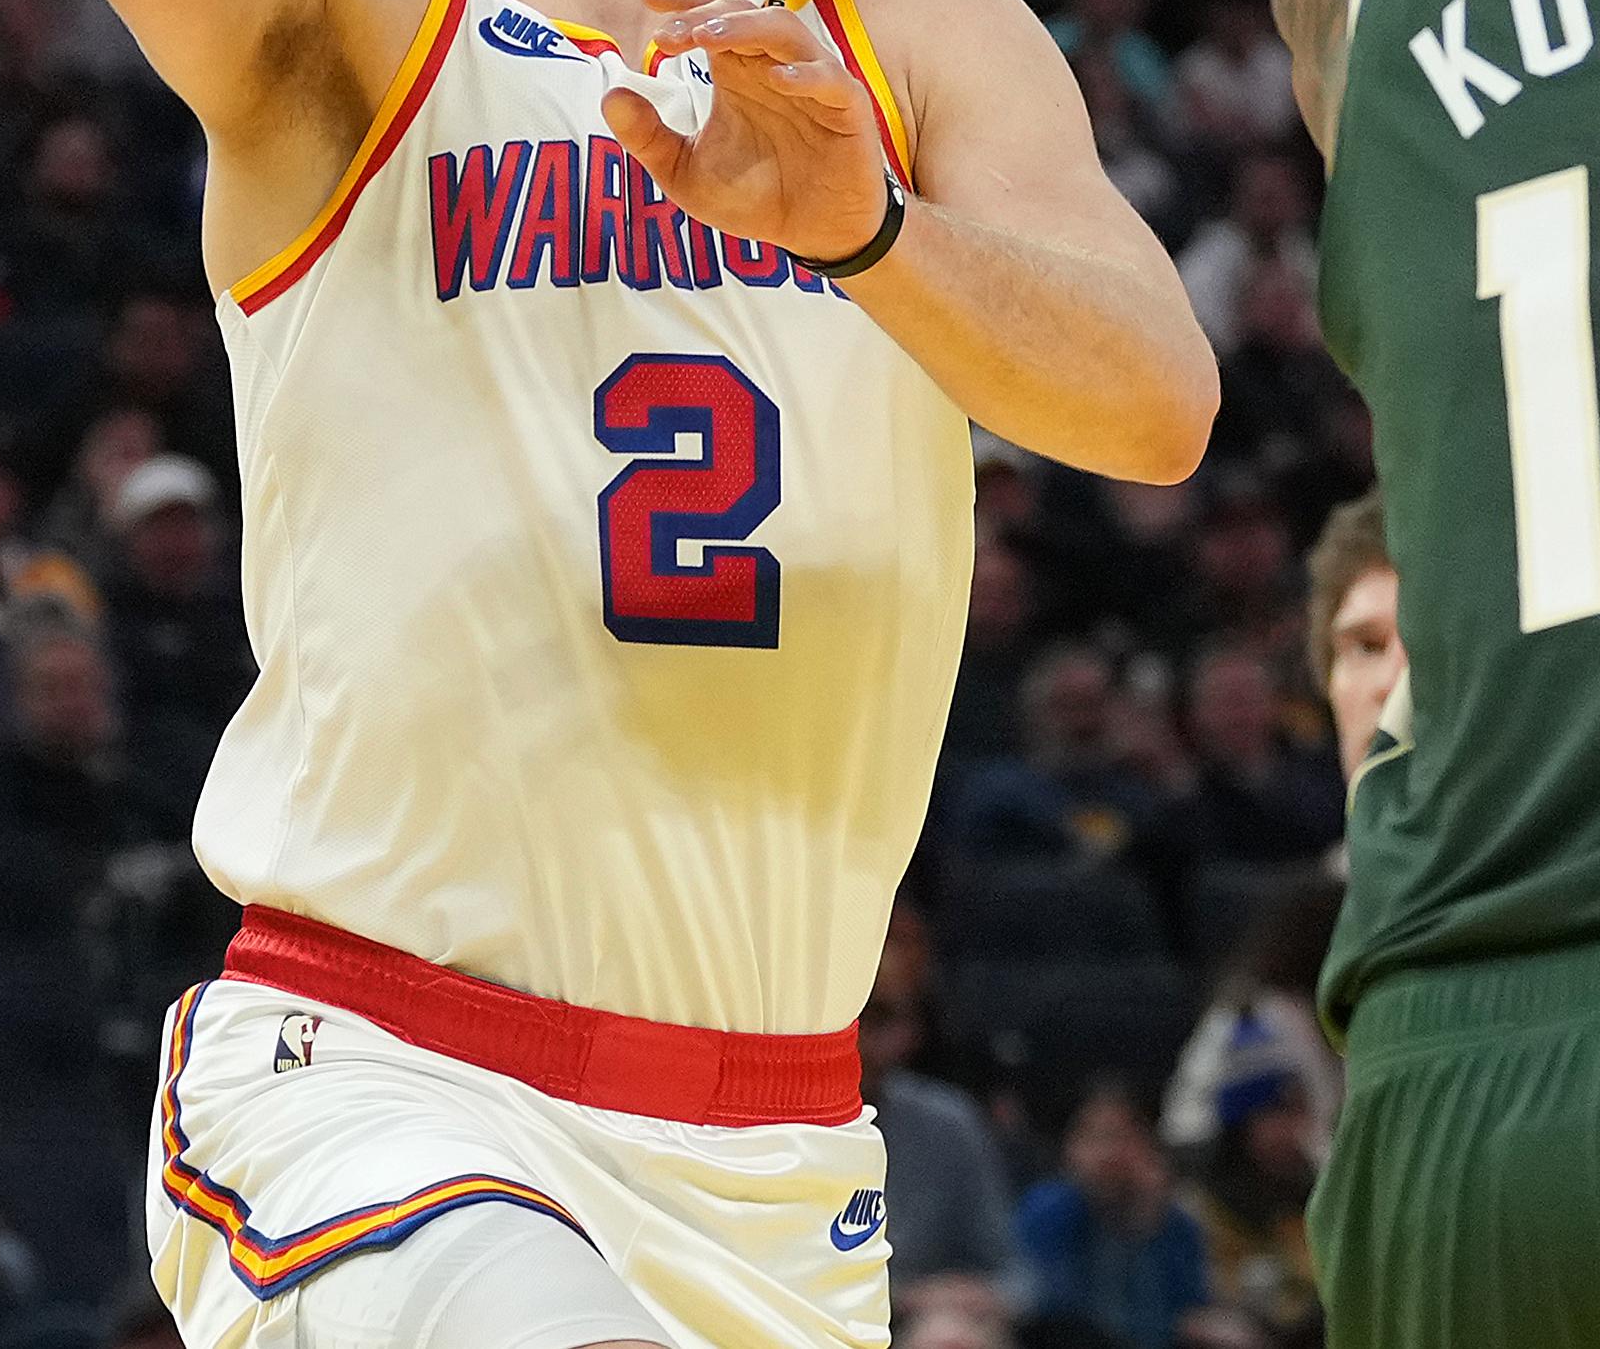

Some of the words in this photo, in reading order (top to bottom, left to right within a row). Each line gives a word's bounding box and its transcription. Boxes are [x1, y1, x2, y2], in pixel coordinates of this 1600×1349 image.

[493, 7, 565, 55] NIKE
[427, 134, 852, 303] WARR
[594, 352, 782, 650] 2
[276, 1058, 302, 1073] NBA
[841, 1189, 884, 1226] NIKE
